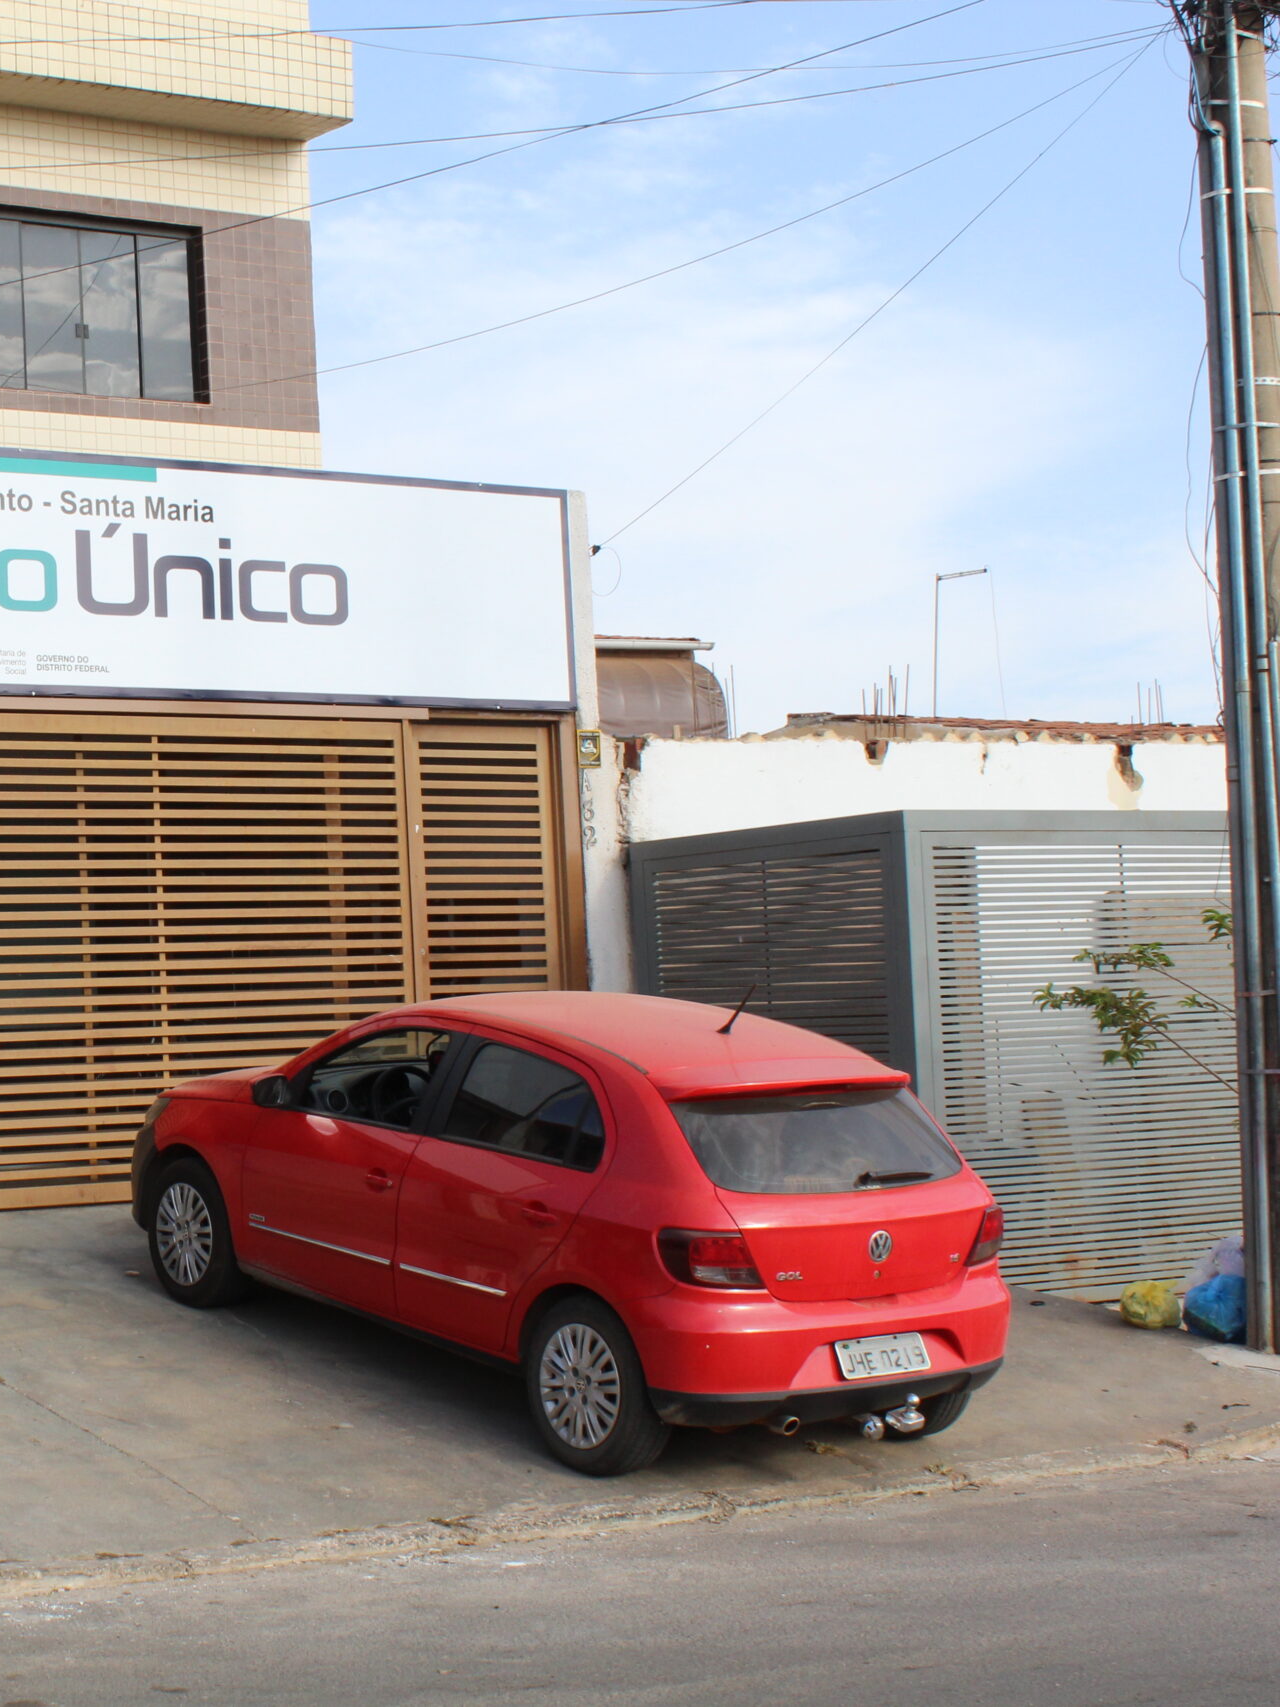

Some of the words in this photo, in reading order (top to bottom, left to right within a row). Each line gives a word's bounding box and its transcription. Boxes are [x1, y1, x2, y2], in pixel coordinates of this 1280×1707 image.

[60, 489, 135, 519] Santa
[144, 495, 215, 524] Maria
[74, 522, 349, 627] Único
[36, 654, 75, 663] GOVERNO
[77, 655, 89, 664] DO
[36, 663, 73, 672] DISTRITO
[74, 665, 110, 673] FEDERAL
[775, 1271, 804, 1281] GOL
